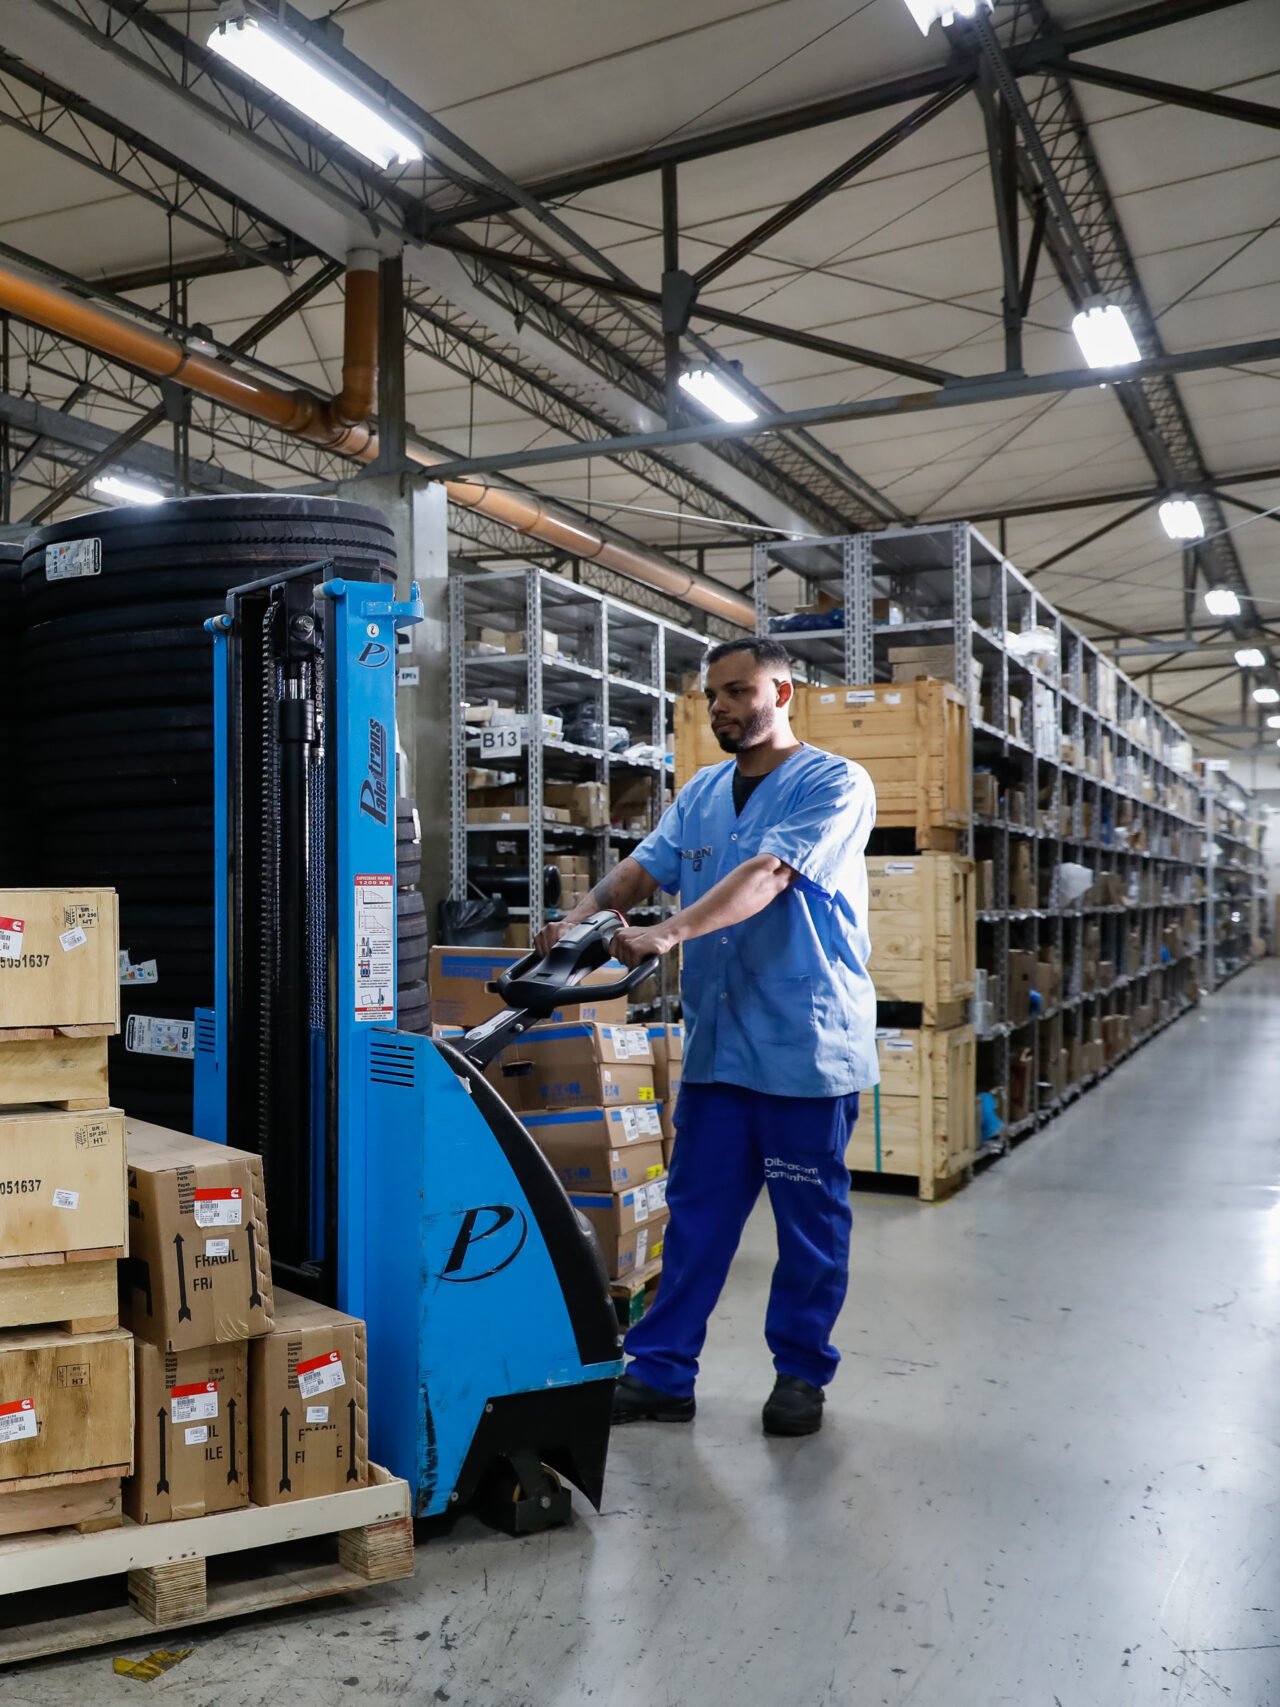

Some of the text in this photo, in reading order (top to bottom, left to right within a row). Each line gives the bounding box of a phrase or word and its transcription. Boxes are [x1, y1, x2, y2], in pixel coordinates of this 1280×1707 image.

[483, 731, 517, 748] B13
[360, 719, 387, 825] Paletrans
[0, 954, 50, 969] 5051637
